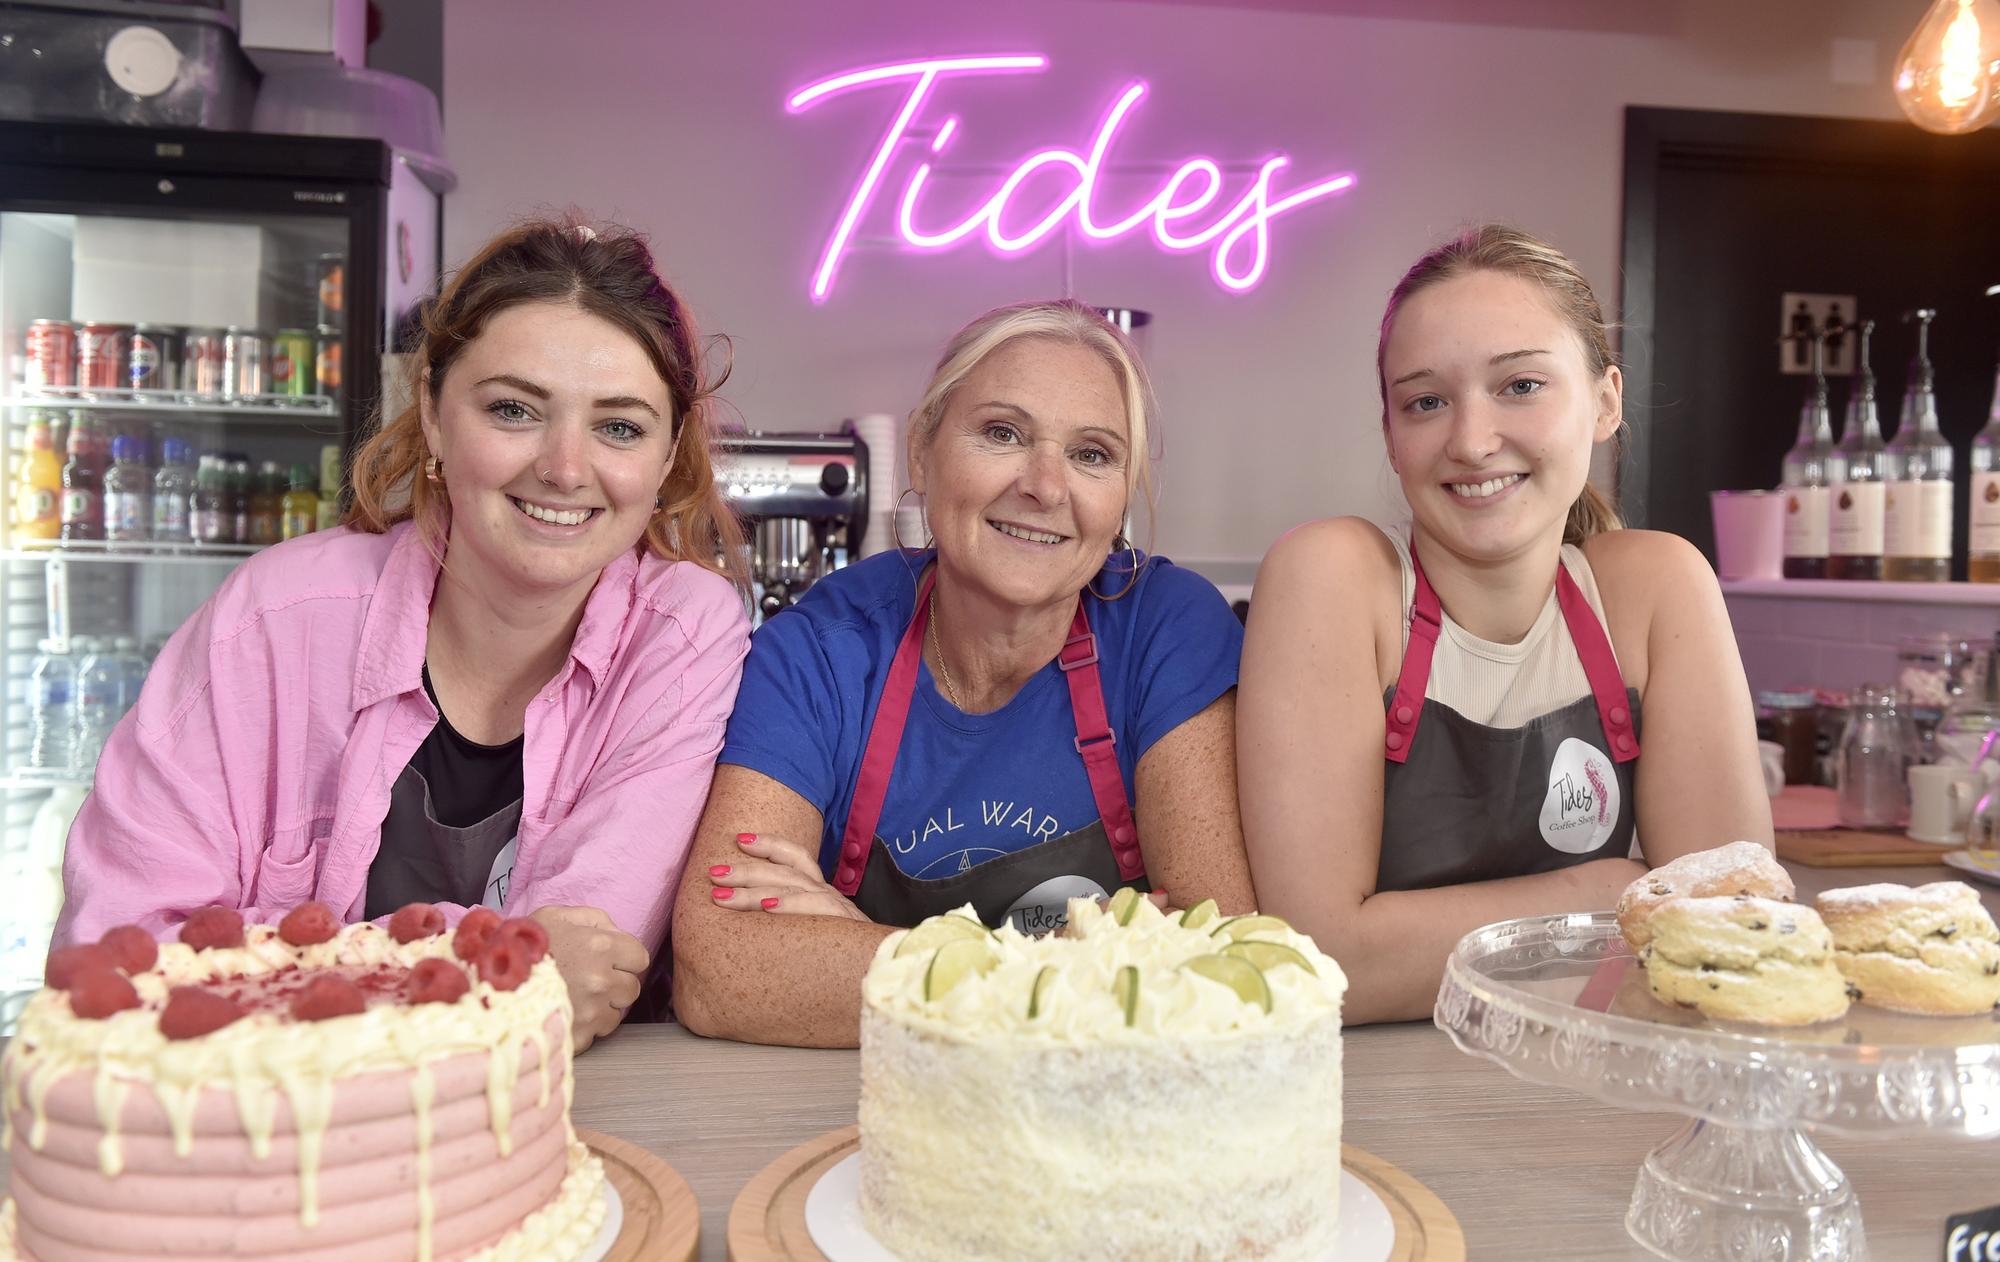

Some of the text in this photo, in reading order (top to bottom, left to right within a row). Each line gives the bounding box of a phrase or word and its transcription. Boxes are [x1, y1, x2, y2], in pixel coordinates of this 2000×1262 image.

[788, 54, 1355, 301] Tides
[1552, 772, 1593, 820] Tides
[886, 800, 1071, 853] UAL WAR
[1549, 814, 1596, 831] Coffee Shop
[1011, 904, 1068, 933] Tides
